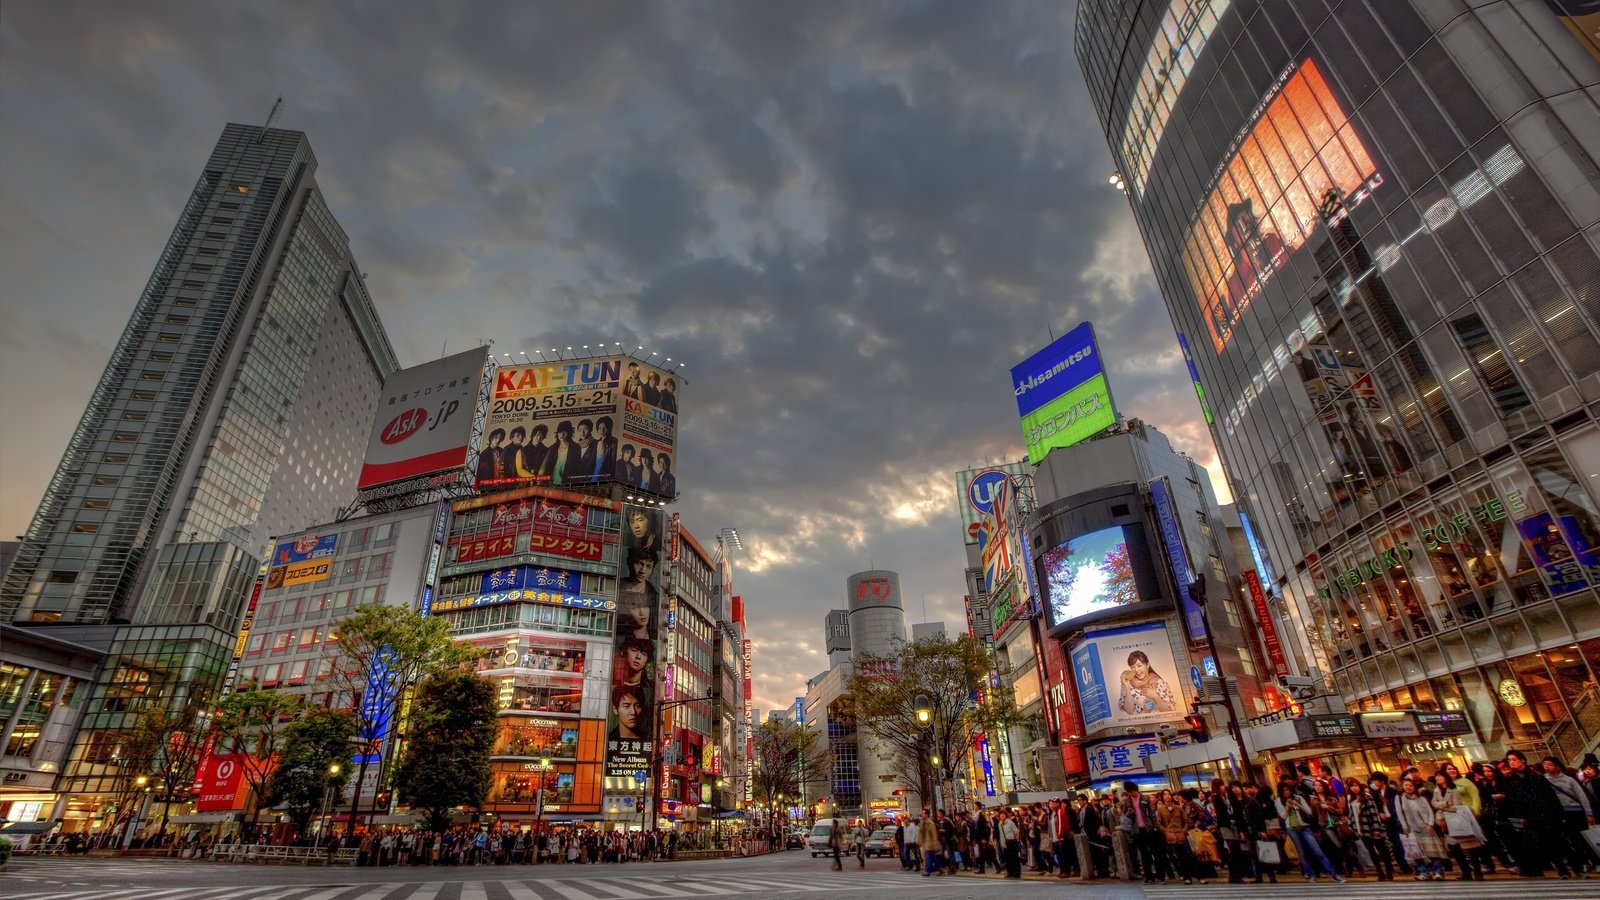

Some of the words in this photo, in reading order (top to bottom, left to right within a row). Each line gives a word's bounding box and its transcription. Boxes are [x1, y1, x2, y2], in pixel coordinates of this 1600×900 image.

[496, 360, 621, 393] KAT-TUN
[1014, 344, 1092, 396] Hisamitsu
[492, 393, 577, 415] 2009.5.15
[625, 399, 675, 426] KAT-TUN
[1027, 392, 1103, 446] サロンパス
[460, 536, 514, 558] プライス
[531, 534, 600, 556] コンタクト
[286, 565, 315, 581] プロミス
[510, 591, 520, 600] 6F
[523, 590, 604, 610] 英会話イーオン
[605, 601, 615, 609] 6F
[608, 740, 652, 752] 東方神起
[612, 756, 626, 764] New
[626, 756, 647, 764] Album
